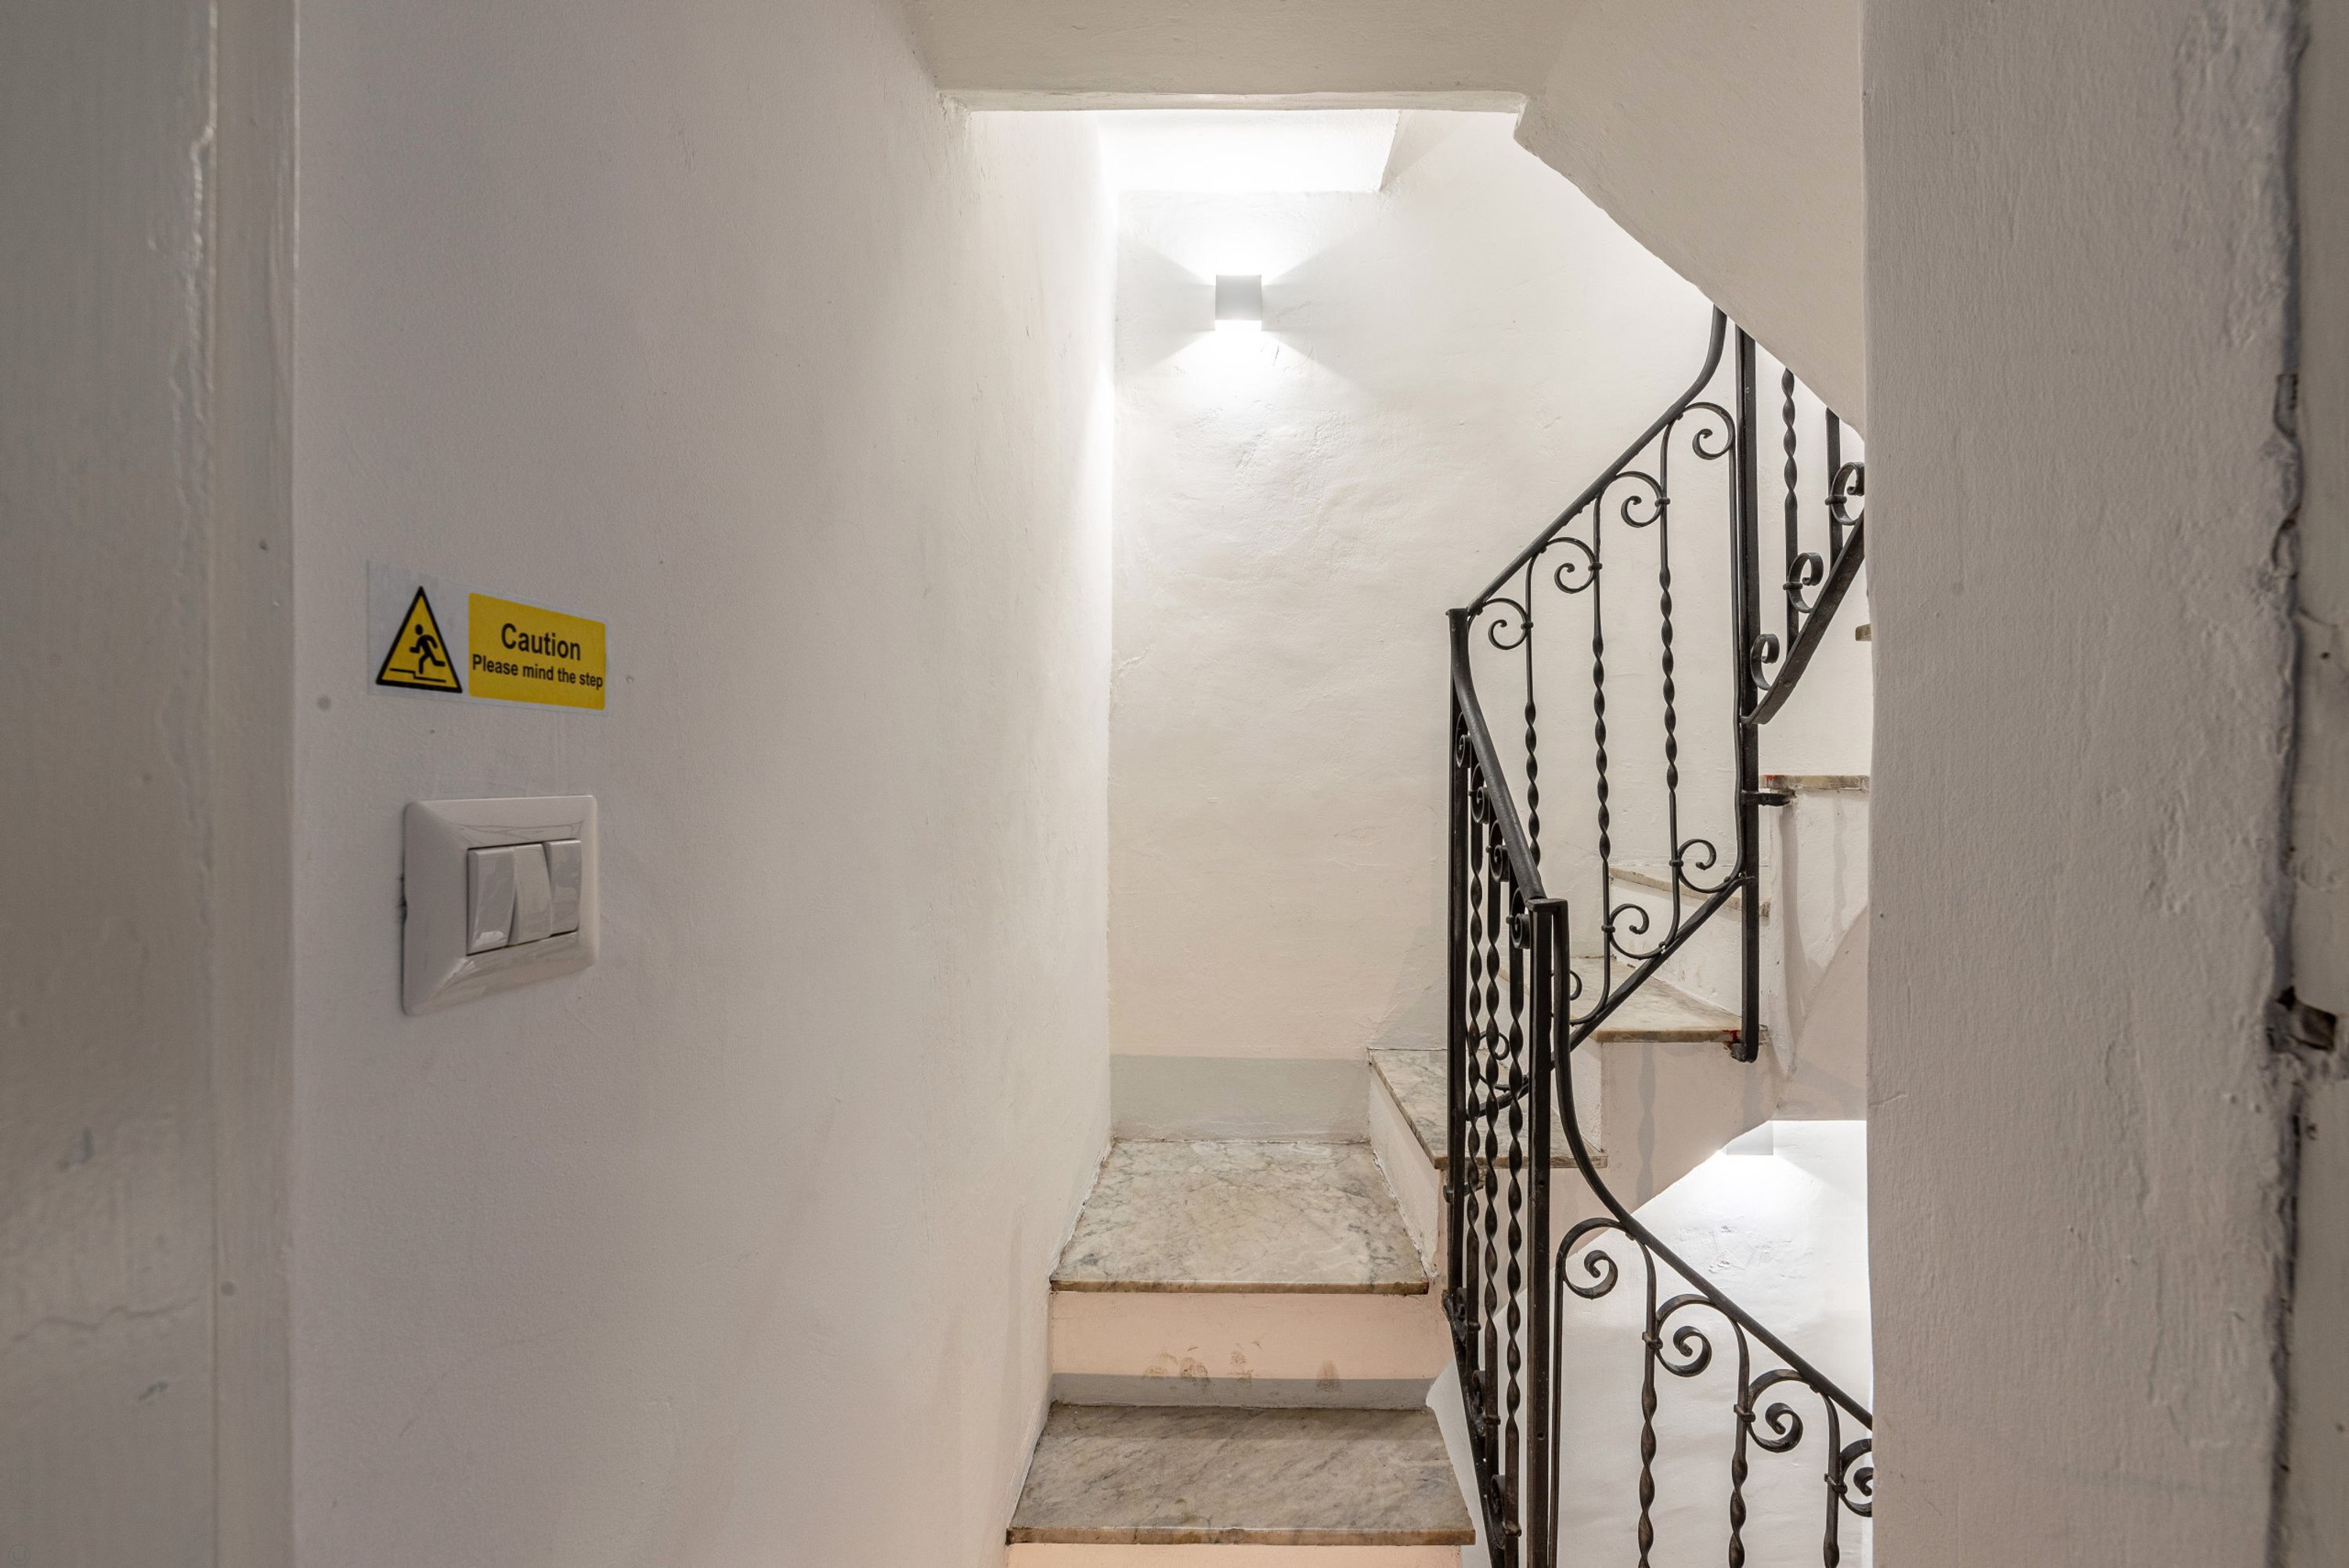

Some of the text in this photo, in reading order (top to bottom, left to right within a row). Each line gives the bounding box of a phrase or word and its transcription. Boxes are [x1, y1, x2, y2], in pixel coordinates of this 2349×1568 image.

[501, 623, 581, 661] Caution
[472, 654, 603, 690] Please mind the step
